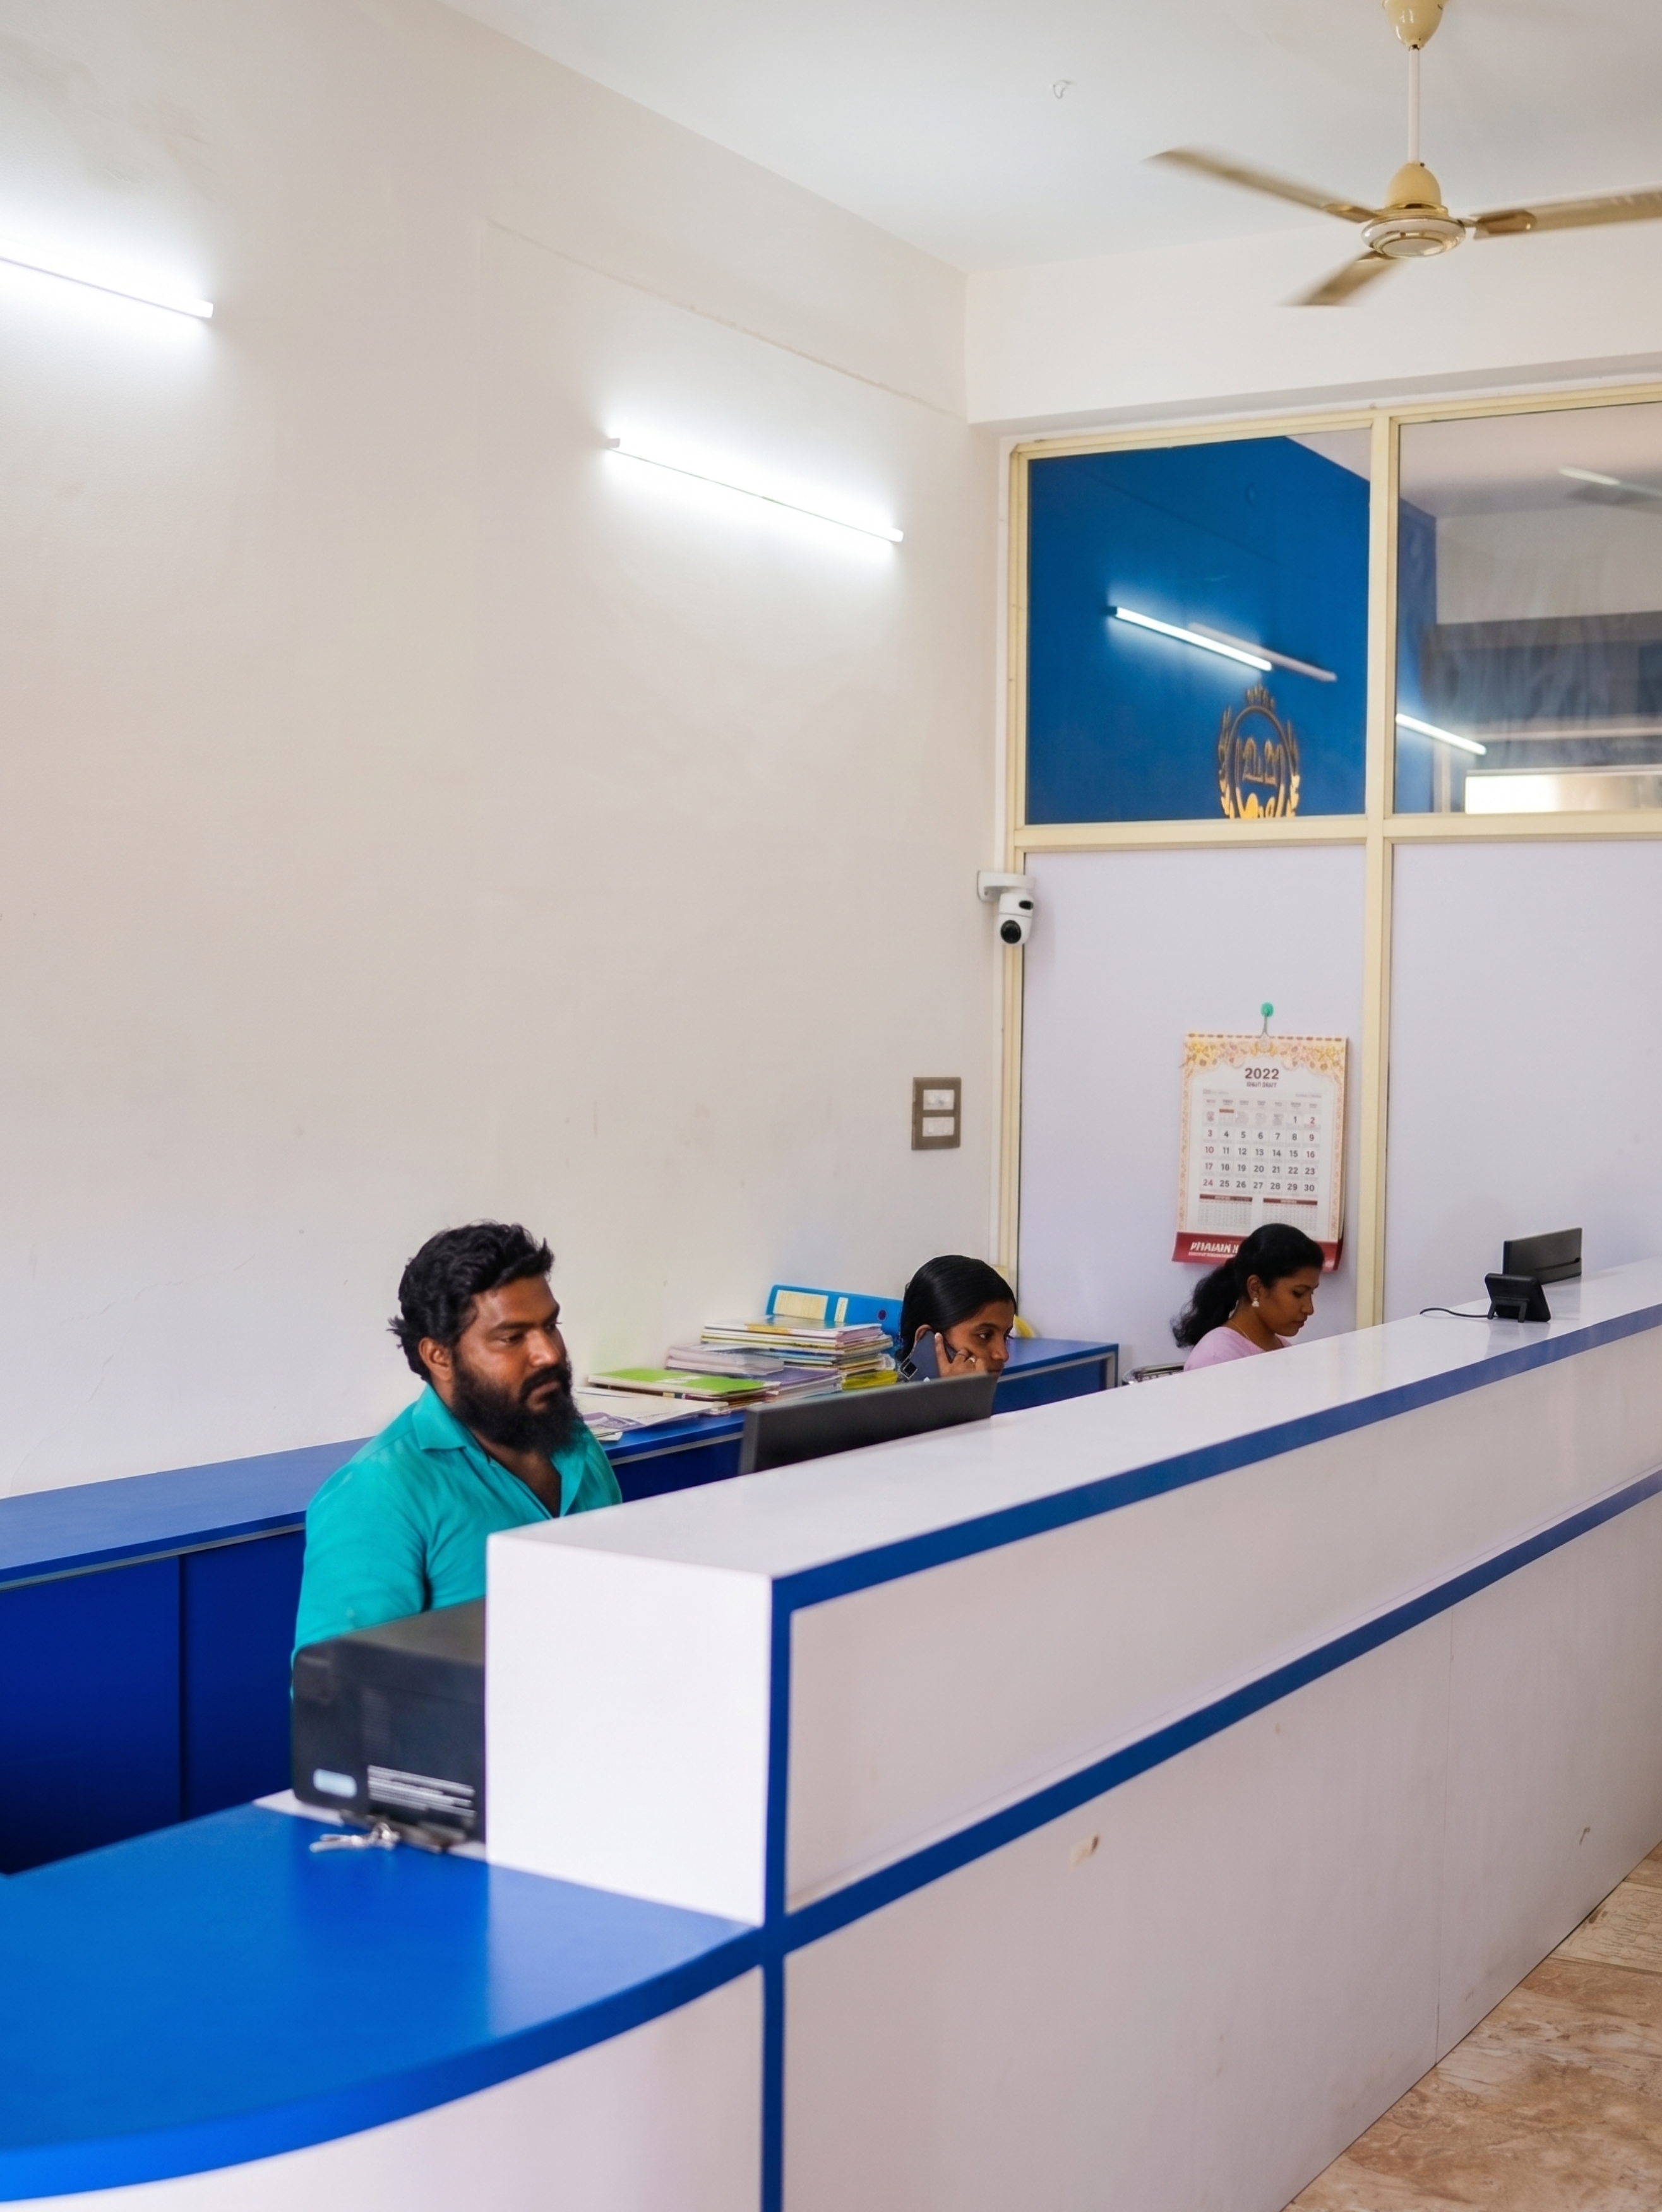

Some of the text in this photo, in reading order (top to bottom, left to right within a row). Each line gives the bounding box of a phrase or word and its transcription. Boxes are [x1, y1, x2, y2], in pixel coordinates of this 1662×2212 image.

[1245, 1067, 1279, 1080] 2022
[1240, 1131, 1246, 1139] 5
[1275, 1133, 1281, 1141] 7
[1205, 1146, 1214, 1154] 10
[1223, 1146, 1229, 1155] 11
[1255, 1148, 1264, 1157] 13
[1289, 1150, 1298, 1158] 15
[1205, 1162, 1214, 1170] 17
[1253, 1165, 1264, 1173] 20
[1288, 1167, 1298, 1175] 22
[1305, 1167, 1315, 1175] 23
[1203, 1179, 1315, 1192] 24 25 26 27 28 29 30
